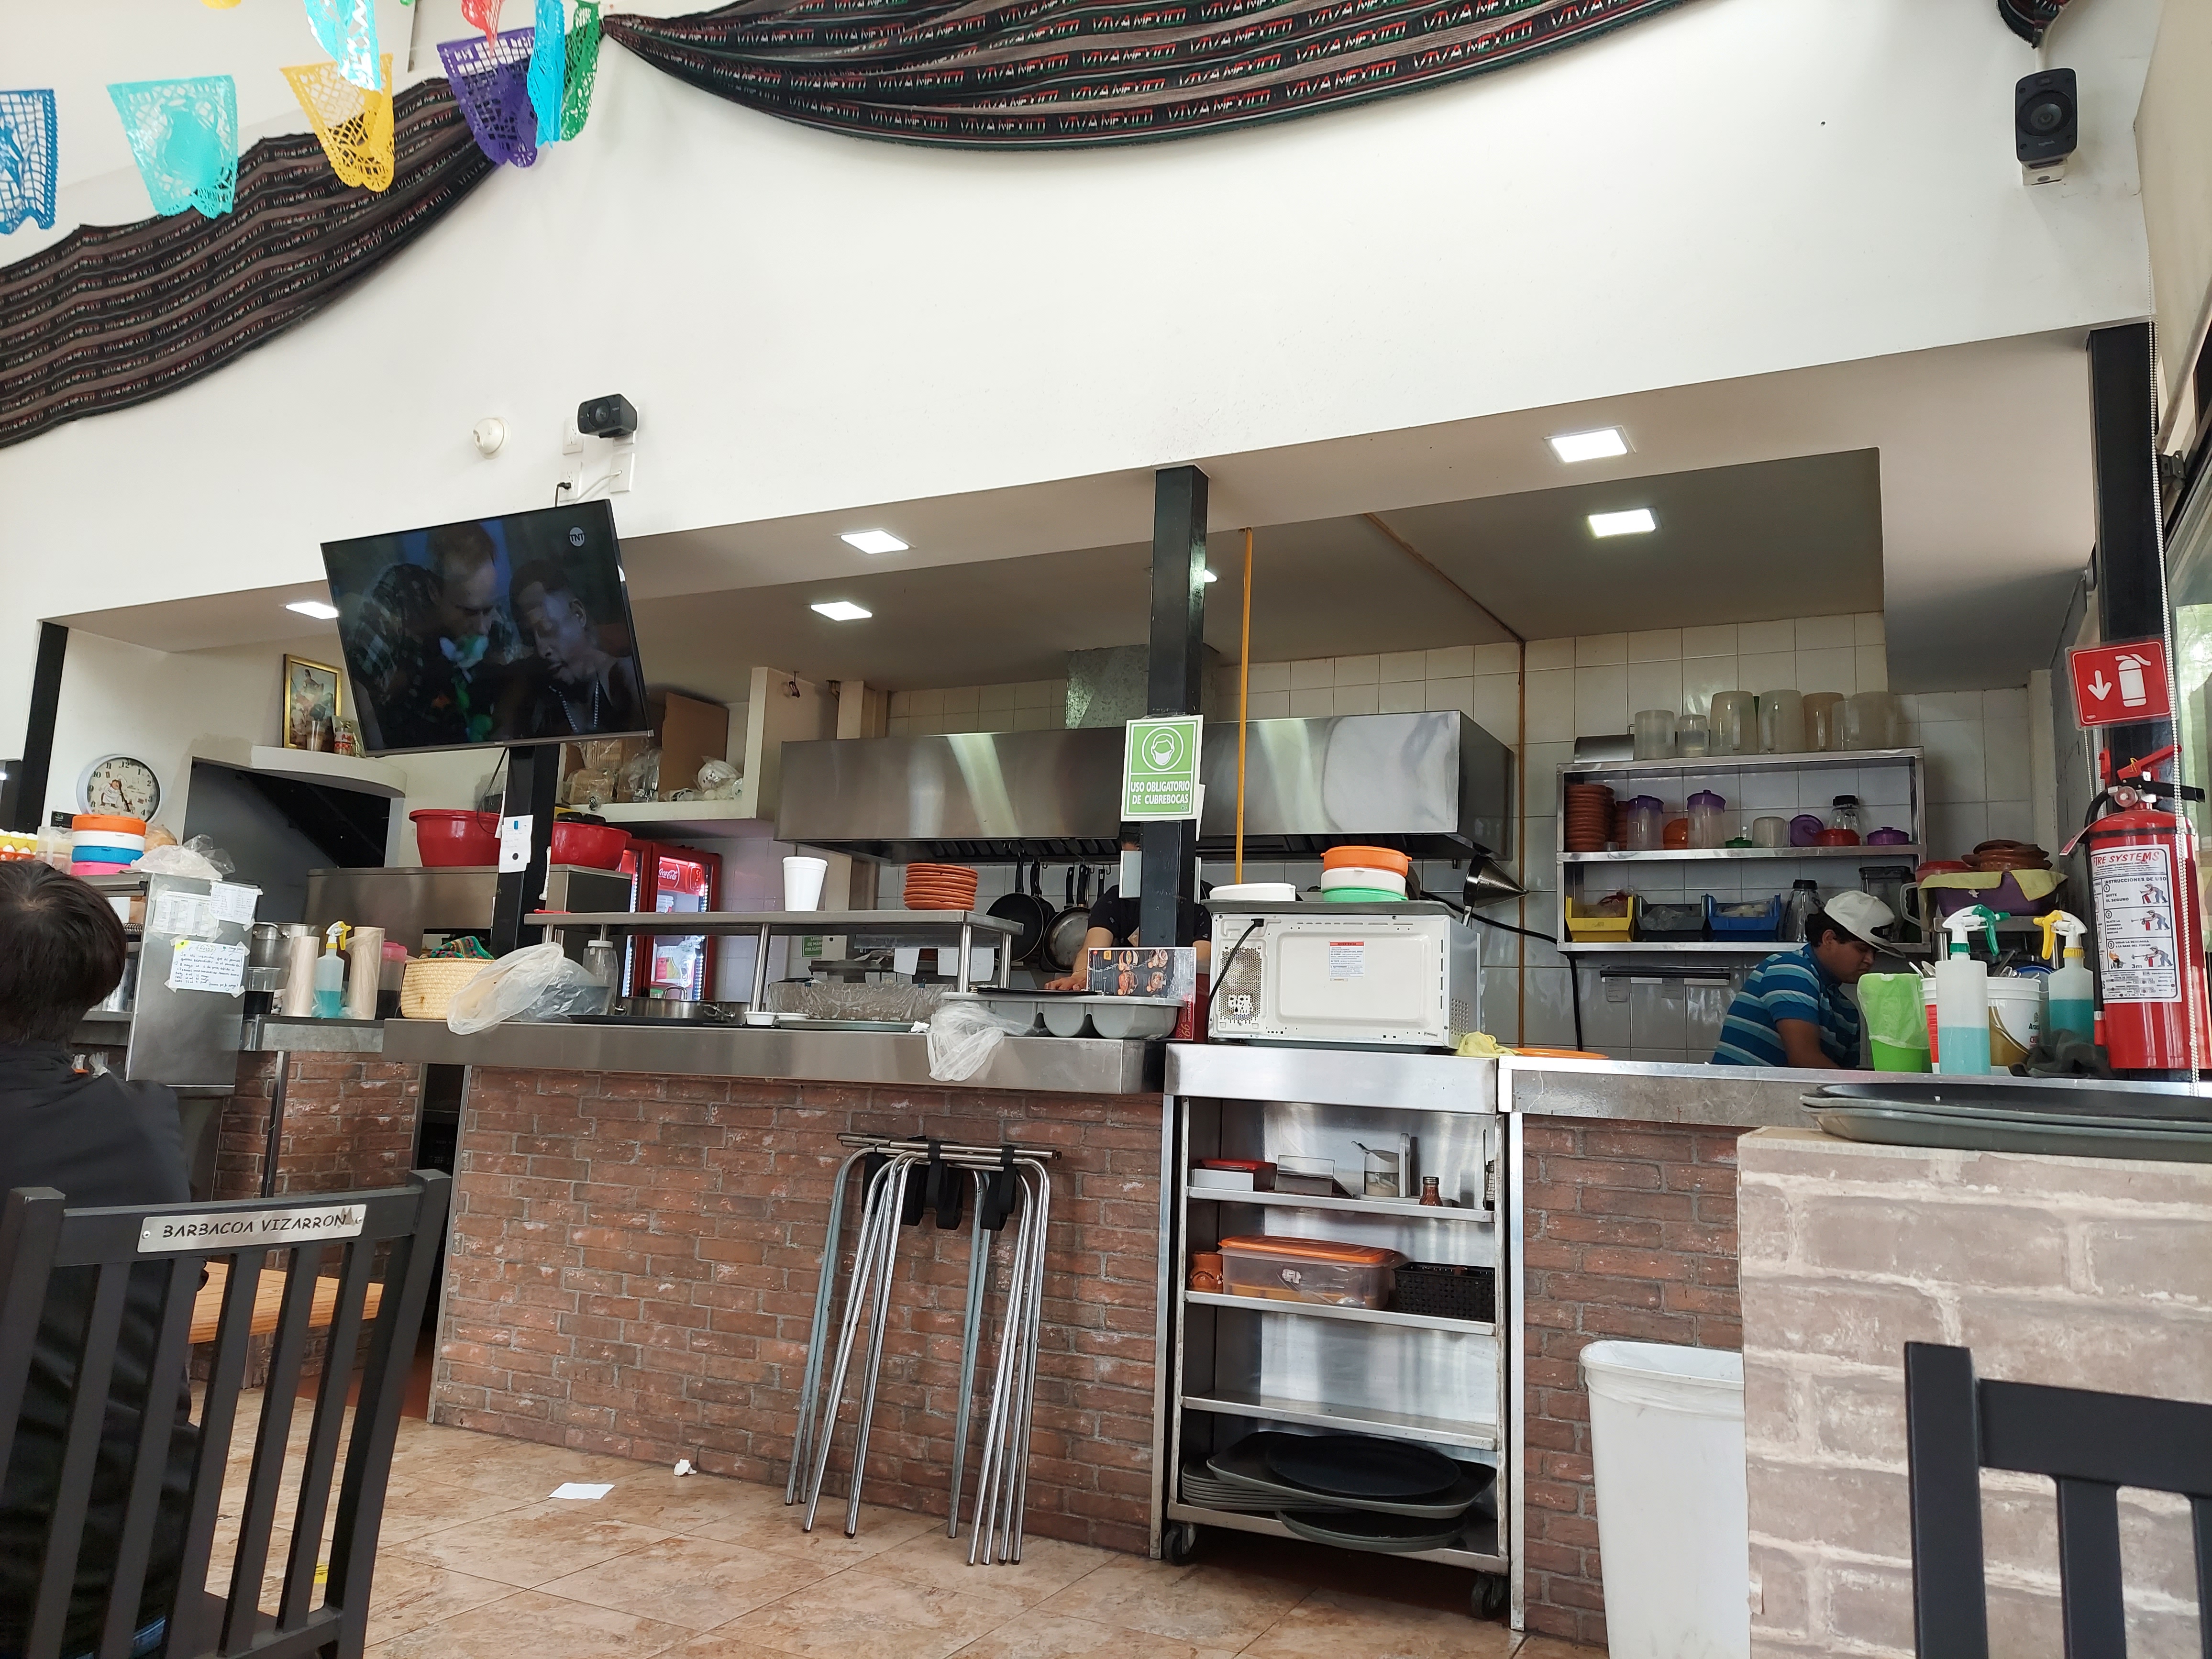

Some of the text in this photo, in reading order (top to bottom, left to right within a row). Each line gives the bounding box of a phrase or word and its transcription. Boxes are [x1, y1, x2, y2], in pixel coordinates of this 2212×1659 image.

[1475, 0, 1541, 19] MEX
[569, 533, 585, 542] TNT
[1130, 780, 1190, 793] USO OBLIGATORIO
[1132, 794, 1189, 805] DE CUBREBOCAS
[2093, 851, 2159, 866] FIRE SYSTEMS
[163, 1215, 346, 1238] BARBACOA VIZARRON
